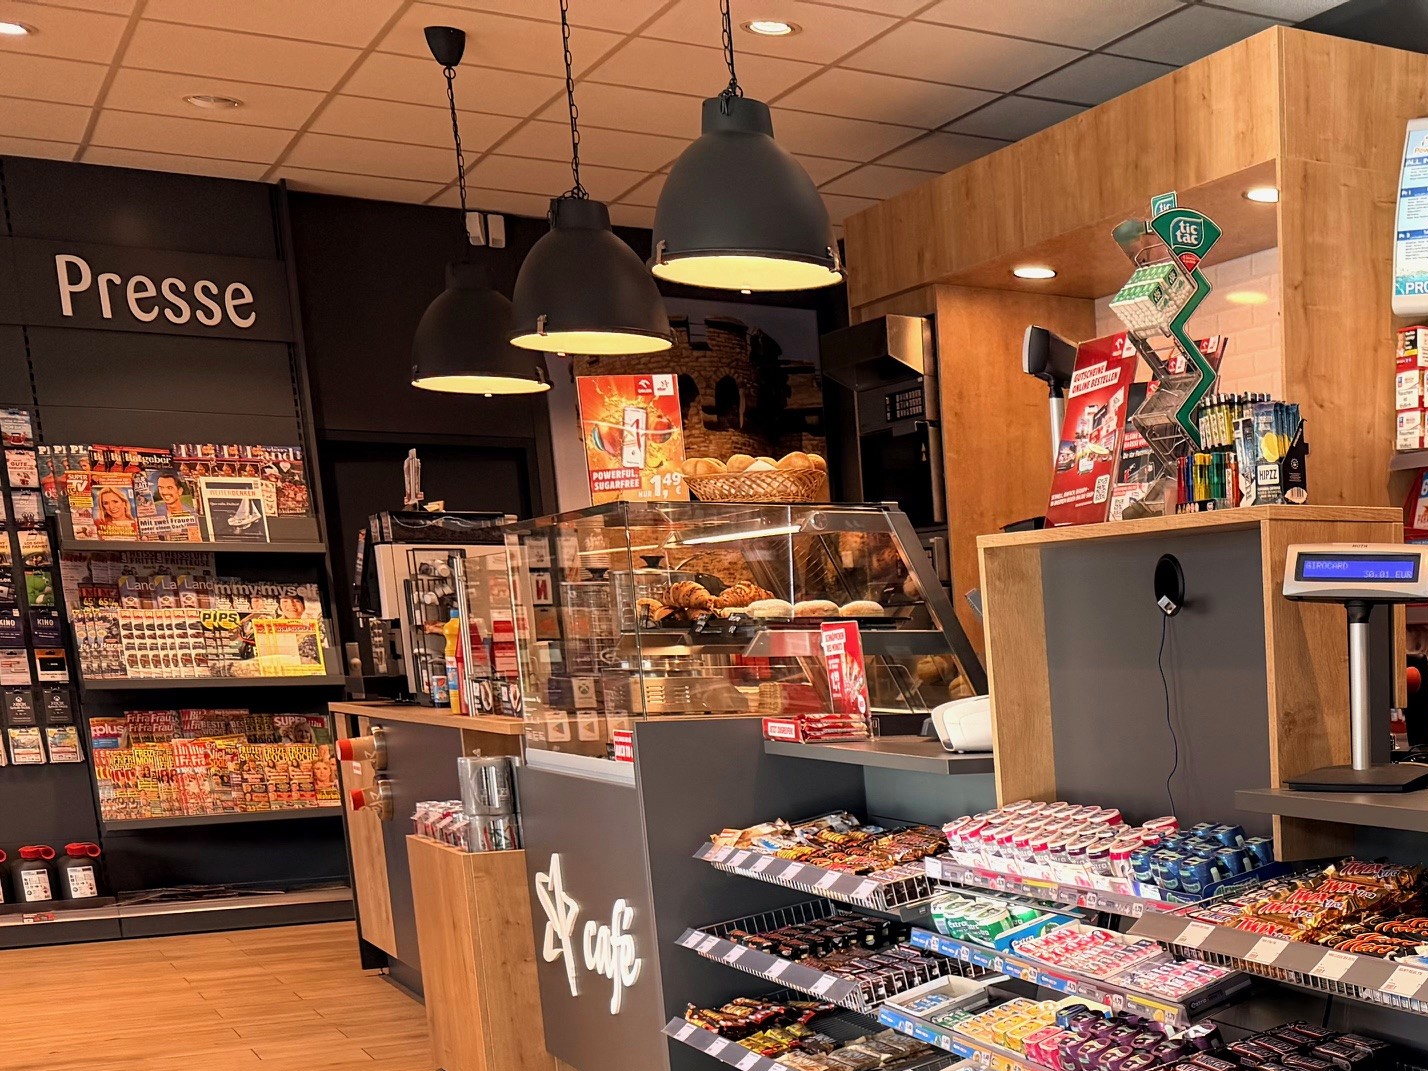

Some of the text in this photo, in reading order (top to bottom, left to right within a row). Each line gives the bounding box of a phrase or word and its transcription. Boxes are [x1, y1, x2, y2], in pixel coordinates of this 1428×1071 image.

[1179, 220, 1198, 234] tic
[1175, 230, 1198, 244] tac
[55, 254, 256, 328] Presse
[1073, 365, 1105, 382] GUTSCHEINE
[1260, 469, 1277, 480] HIPZZ
[594, 479, 640, 490] SUGARFREE
[584, 899, 641, 1015] café
